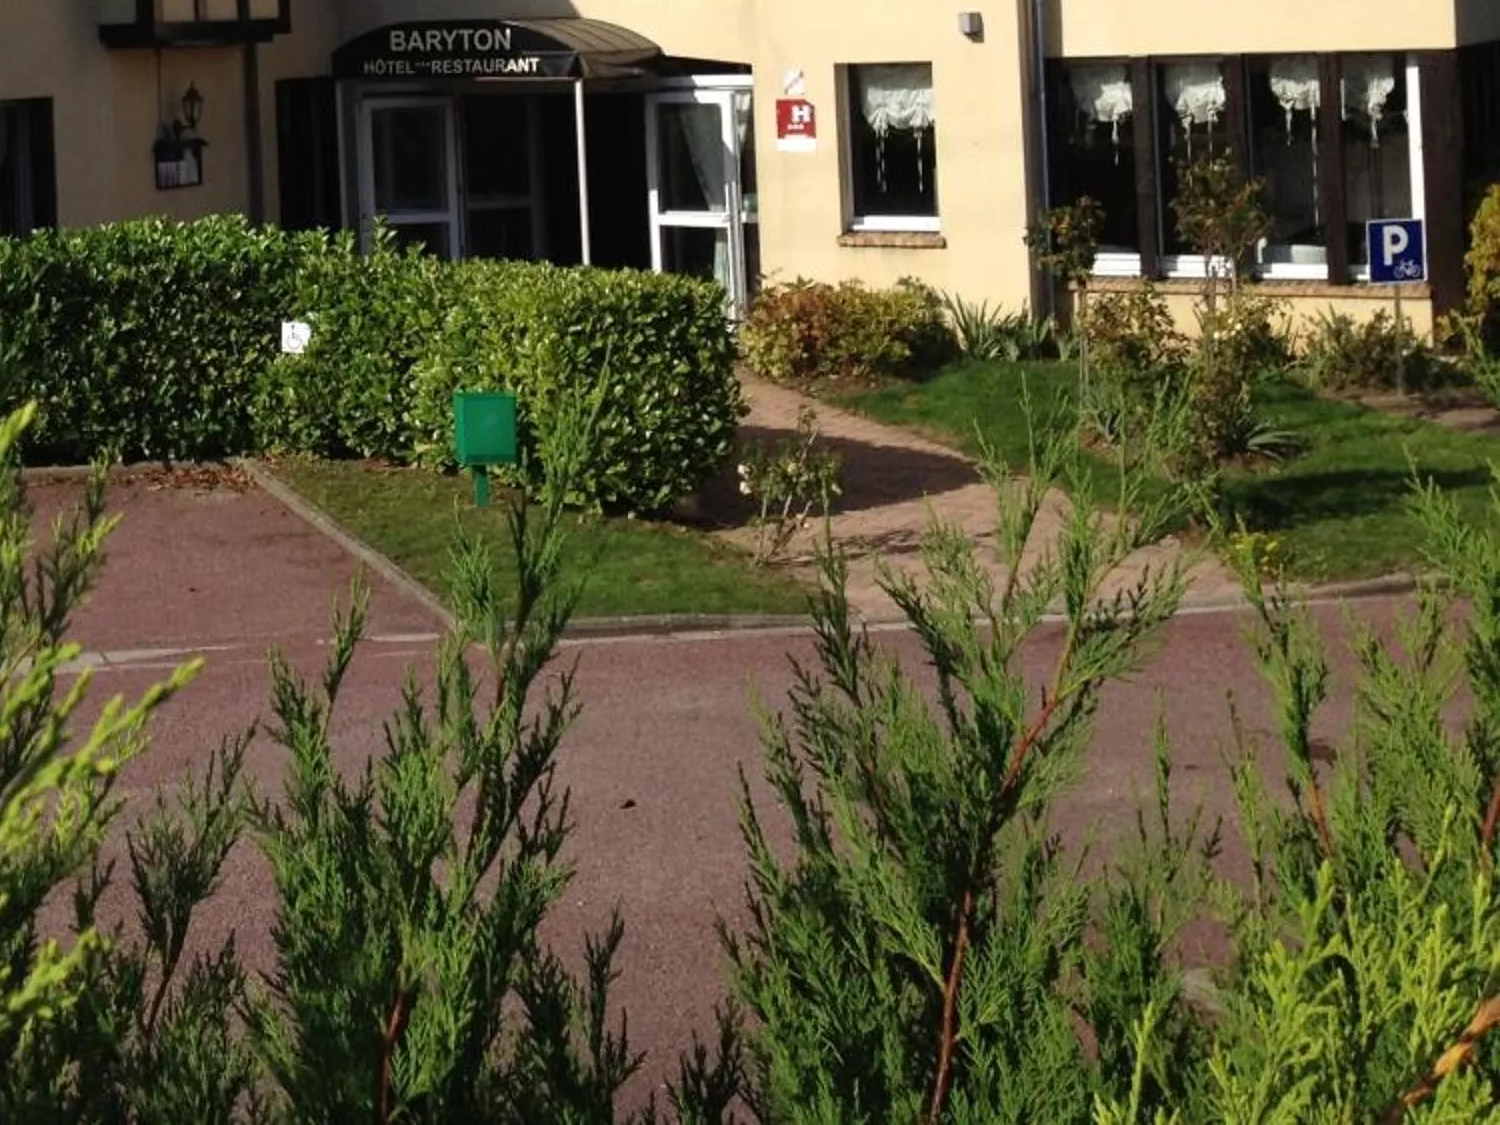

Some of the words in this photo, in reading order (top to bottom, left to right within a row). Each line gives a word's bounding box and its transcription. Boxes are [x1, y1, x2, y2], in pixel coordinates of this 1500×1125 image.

[389, 28, 512, 52] BARYTON
[431, 56, 541, 75] RESTAURANT
[791, 104, 811, 123] H
[1383, 224, 1409, 266] P
